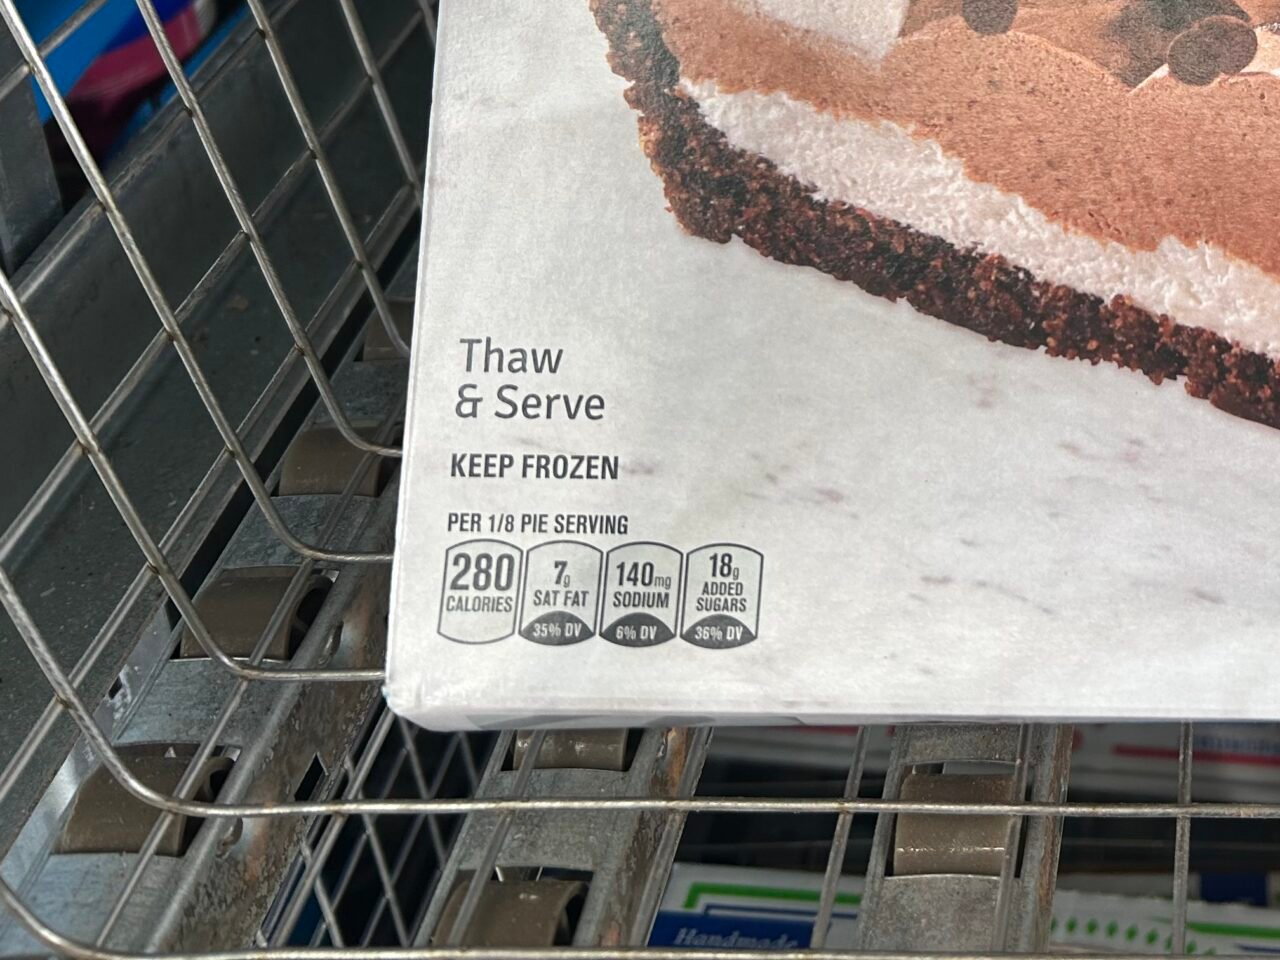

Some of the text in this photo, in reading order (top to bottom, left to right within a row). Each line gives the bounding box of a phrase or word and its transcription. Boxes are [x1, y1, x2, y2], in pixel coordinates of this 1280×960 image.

[460, 336, 564, 374] Thaw
[455, 383, 605, 420] & Serve
[450, 453, 620, 480] KEEP FROZEN
[447, 513, 629, 535] PER 1/8 PIE SERVING
[450, 552, 515, 591] 280
[616, 561, 672, 590] 140mg
[702, 582, 744, 597] ADDED
[446, 595, 513, 613] CALORIES
[533, 590, 589, 608] SAT FAT
[613, 591, 670, 609] SODIUM
[696, 597, 747, 613] SUGARS
[532, 622, 582, 638] 35% DV
[615, 625, 657, 640] 6% DV
[695, 625, 743, 641] 36% DV
